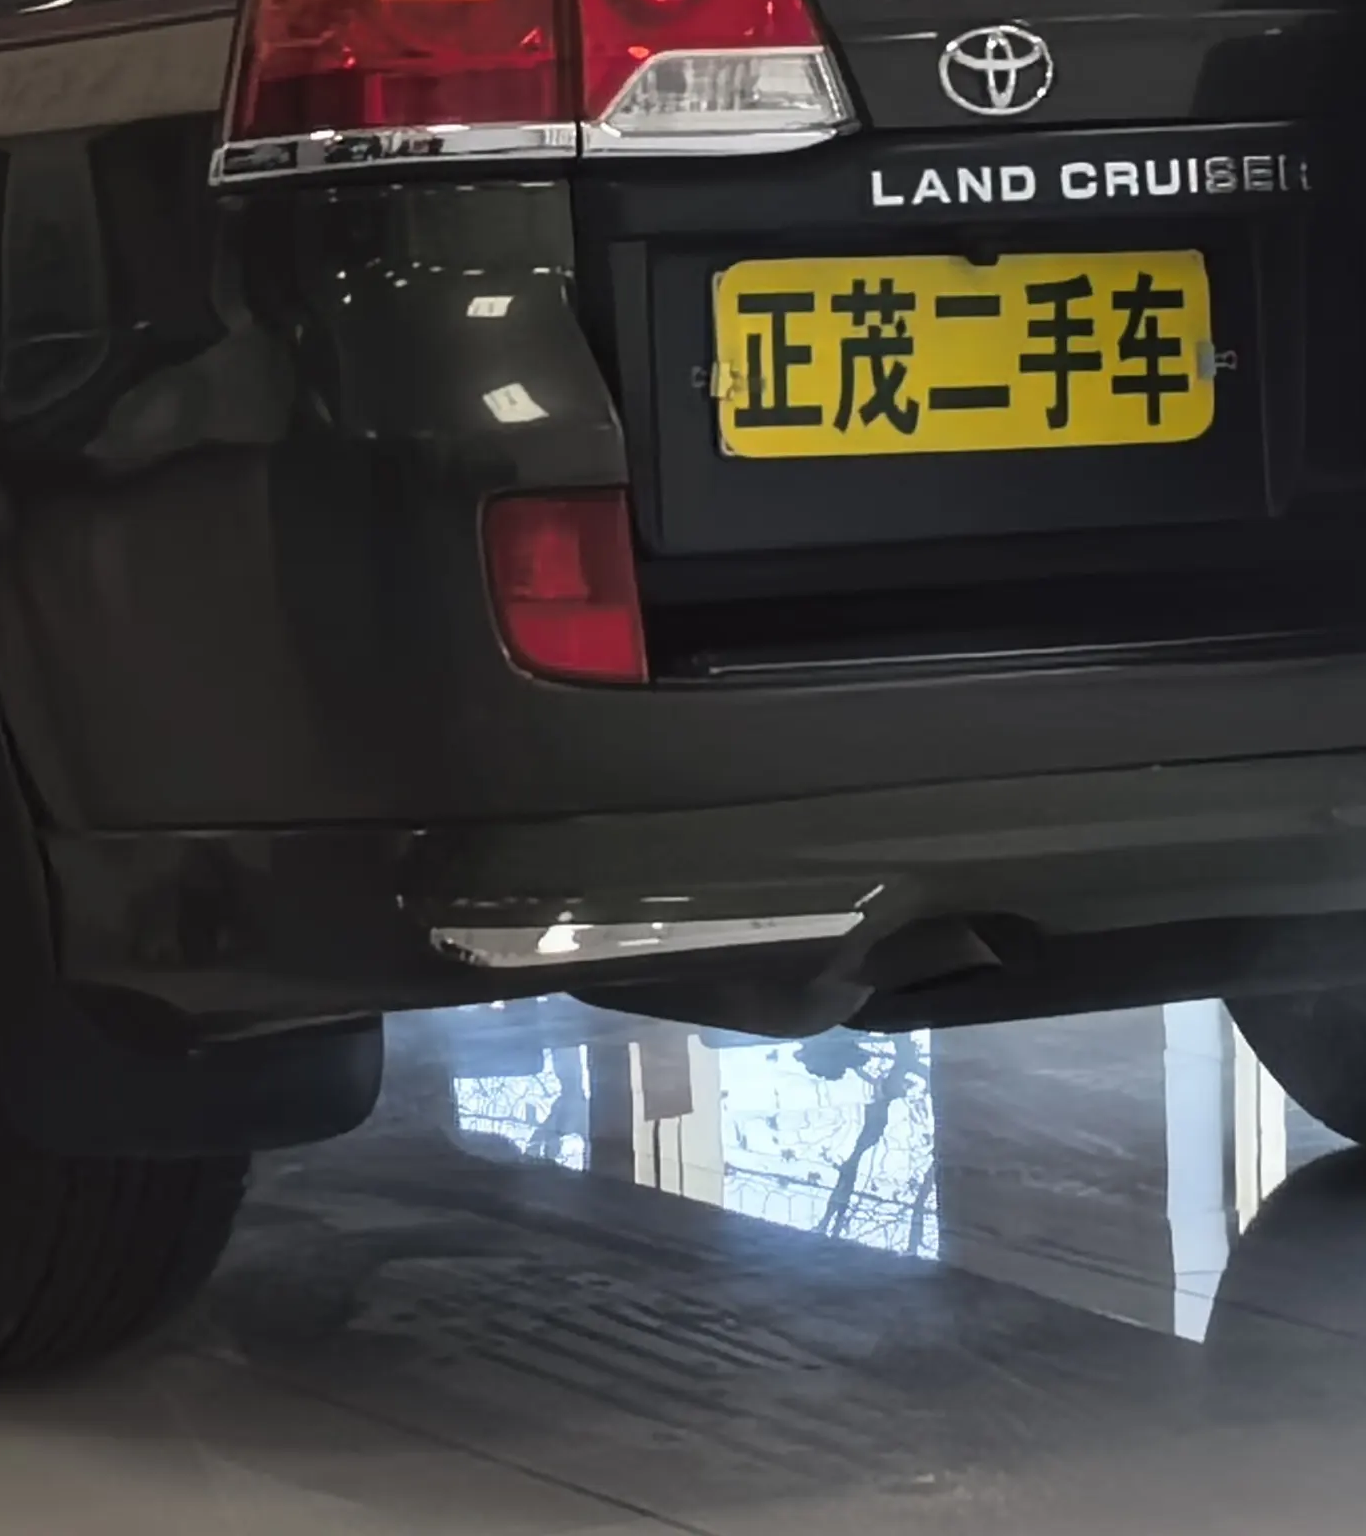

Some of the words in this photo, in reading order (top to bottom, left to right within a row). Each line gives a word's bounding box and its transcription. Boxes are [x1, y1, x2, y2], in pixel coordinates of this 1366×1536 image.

[871, 165, 1036, 207] LAND
[733, 272, 1191, 435] 正茂二手车
